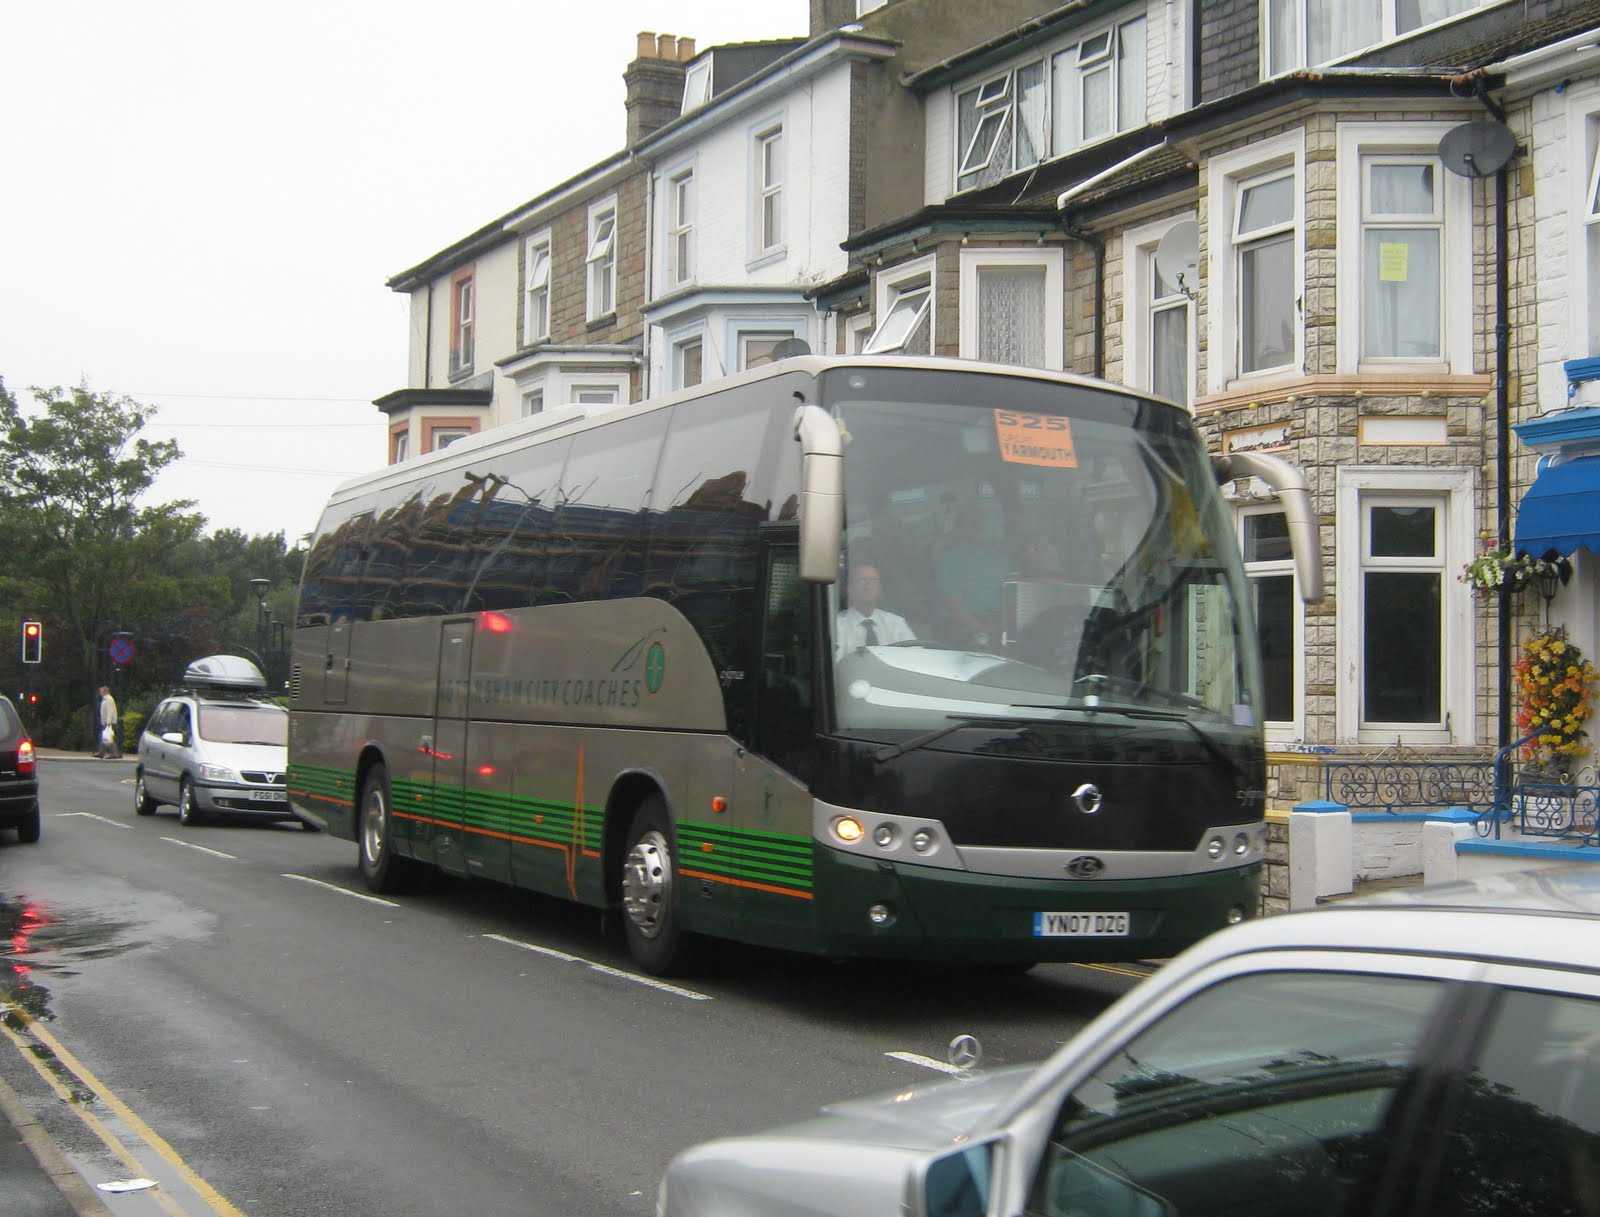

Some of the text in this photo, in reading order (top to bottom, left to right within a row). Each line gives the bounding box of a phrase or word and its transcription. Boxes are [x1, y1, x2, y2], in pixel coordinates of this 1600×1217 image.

[998, 411, 1066, 431] 525
[1003, 443, 1073, 461] YARMOUTH
[561, 680, 641, 707] COACHES
[1046, 915, 1126, 933] YN07 DZG
